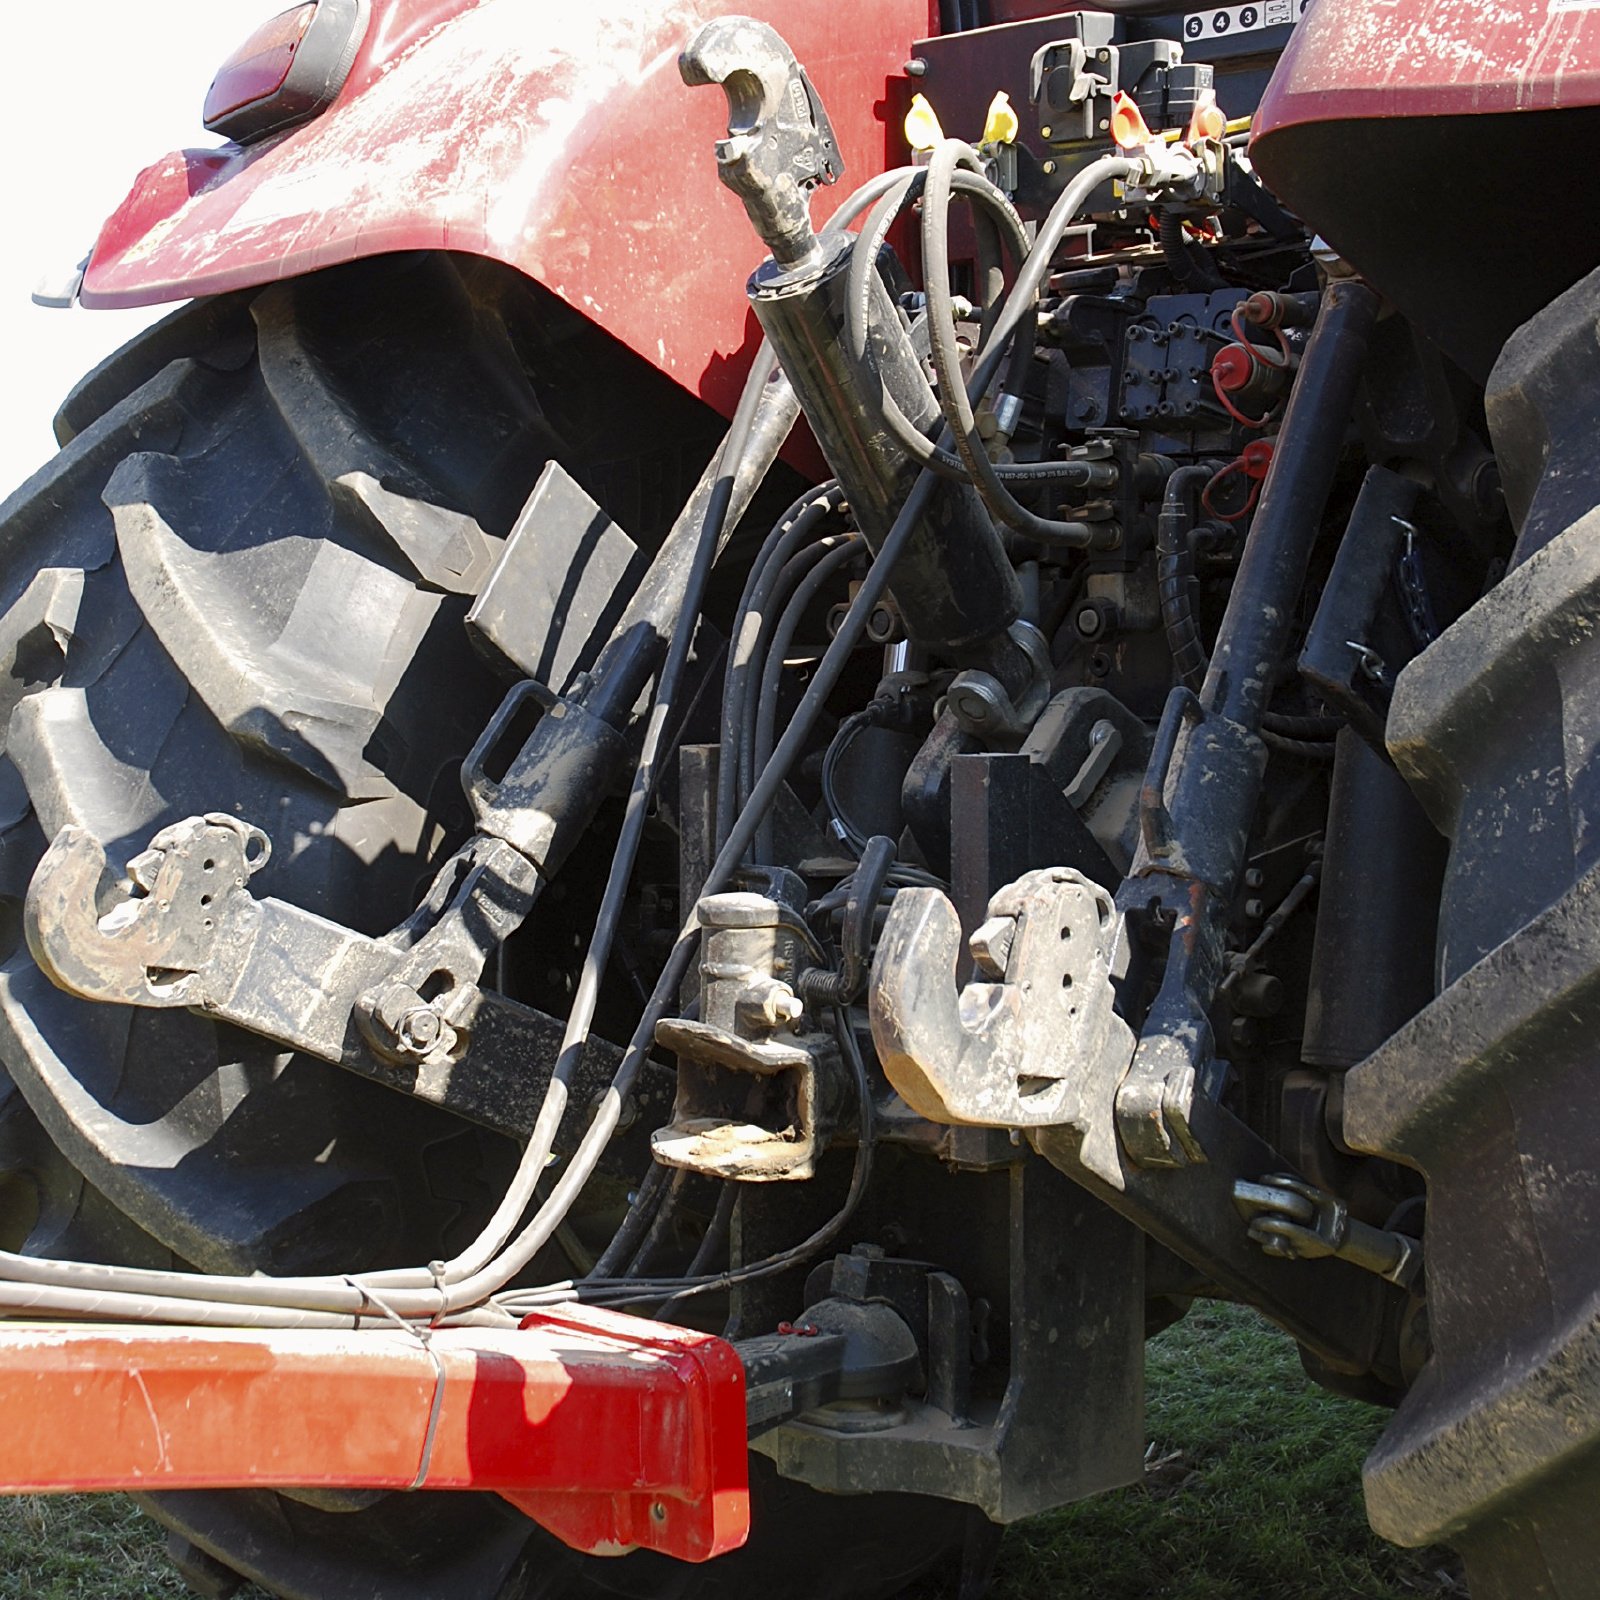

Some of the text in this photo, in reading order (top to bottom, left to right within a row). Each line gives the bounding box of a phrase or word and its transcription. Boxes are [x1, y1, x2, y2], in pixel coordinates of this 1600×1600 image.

[1191, 11, 1252, 33] 5 4 3
